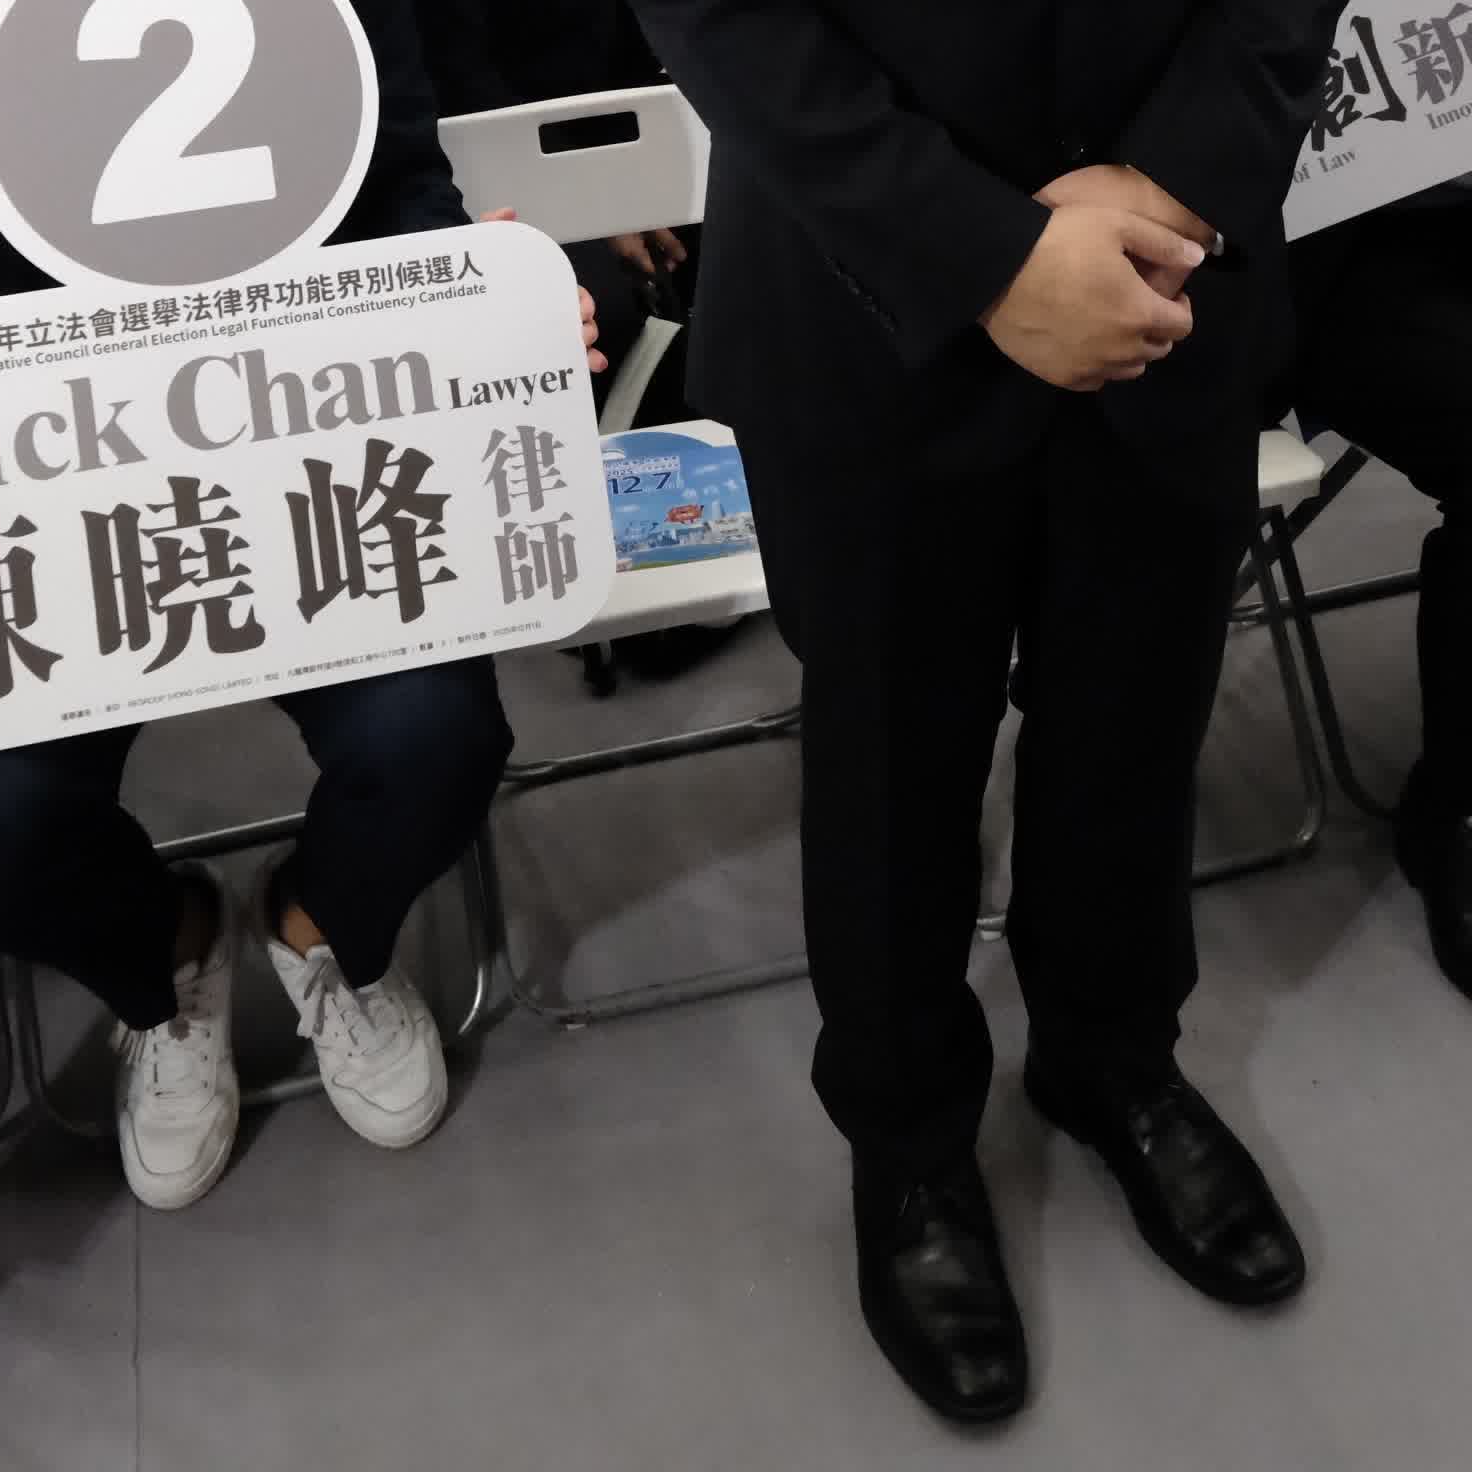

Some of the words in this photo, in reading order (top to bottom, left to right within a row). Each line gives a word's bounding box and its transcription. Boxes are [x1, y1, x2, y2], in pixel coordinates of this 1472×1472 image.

[1320, 147, 1357, 174] Law
[34, 345, 90, 366] Council
[93, 334, 149, 356] General
[151, 326, 208, 348] Election
[210, 318, 249, 339] Legal
[251, 309, 325, 331] Functional
[327, 294, 417, 319] Constituency
[419, 283, 488, 305] Candidate
[166, 347, 440, 452] Chan
[447, 367, 575, 410] Lawyer
[480, 424, 579, 606] 律師
